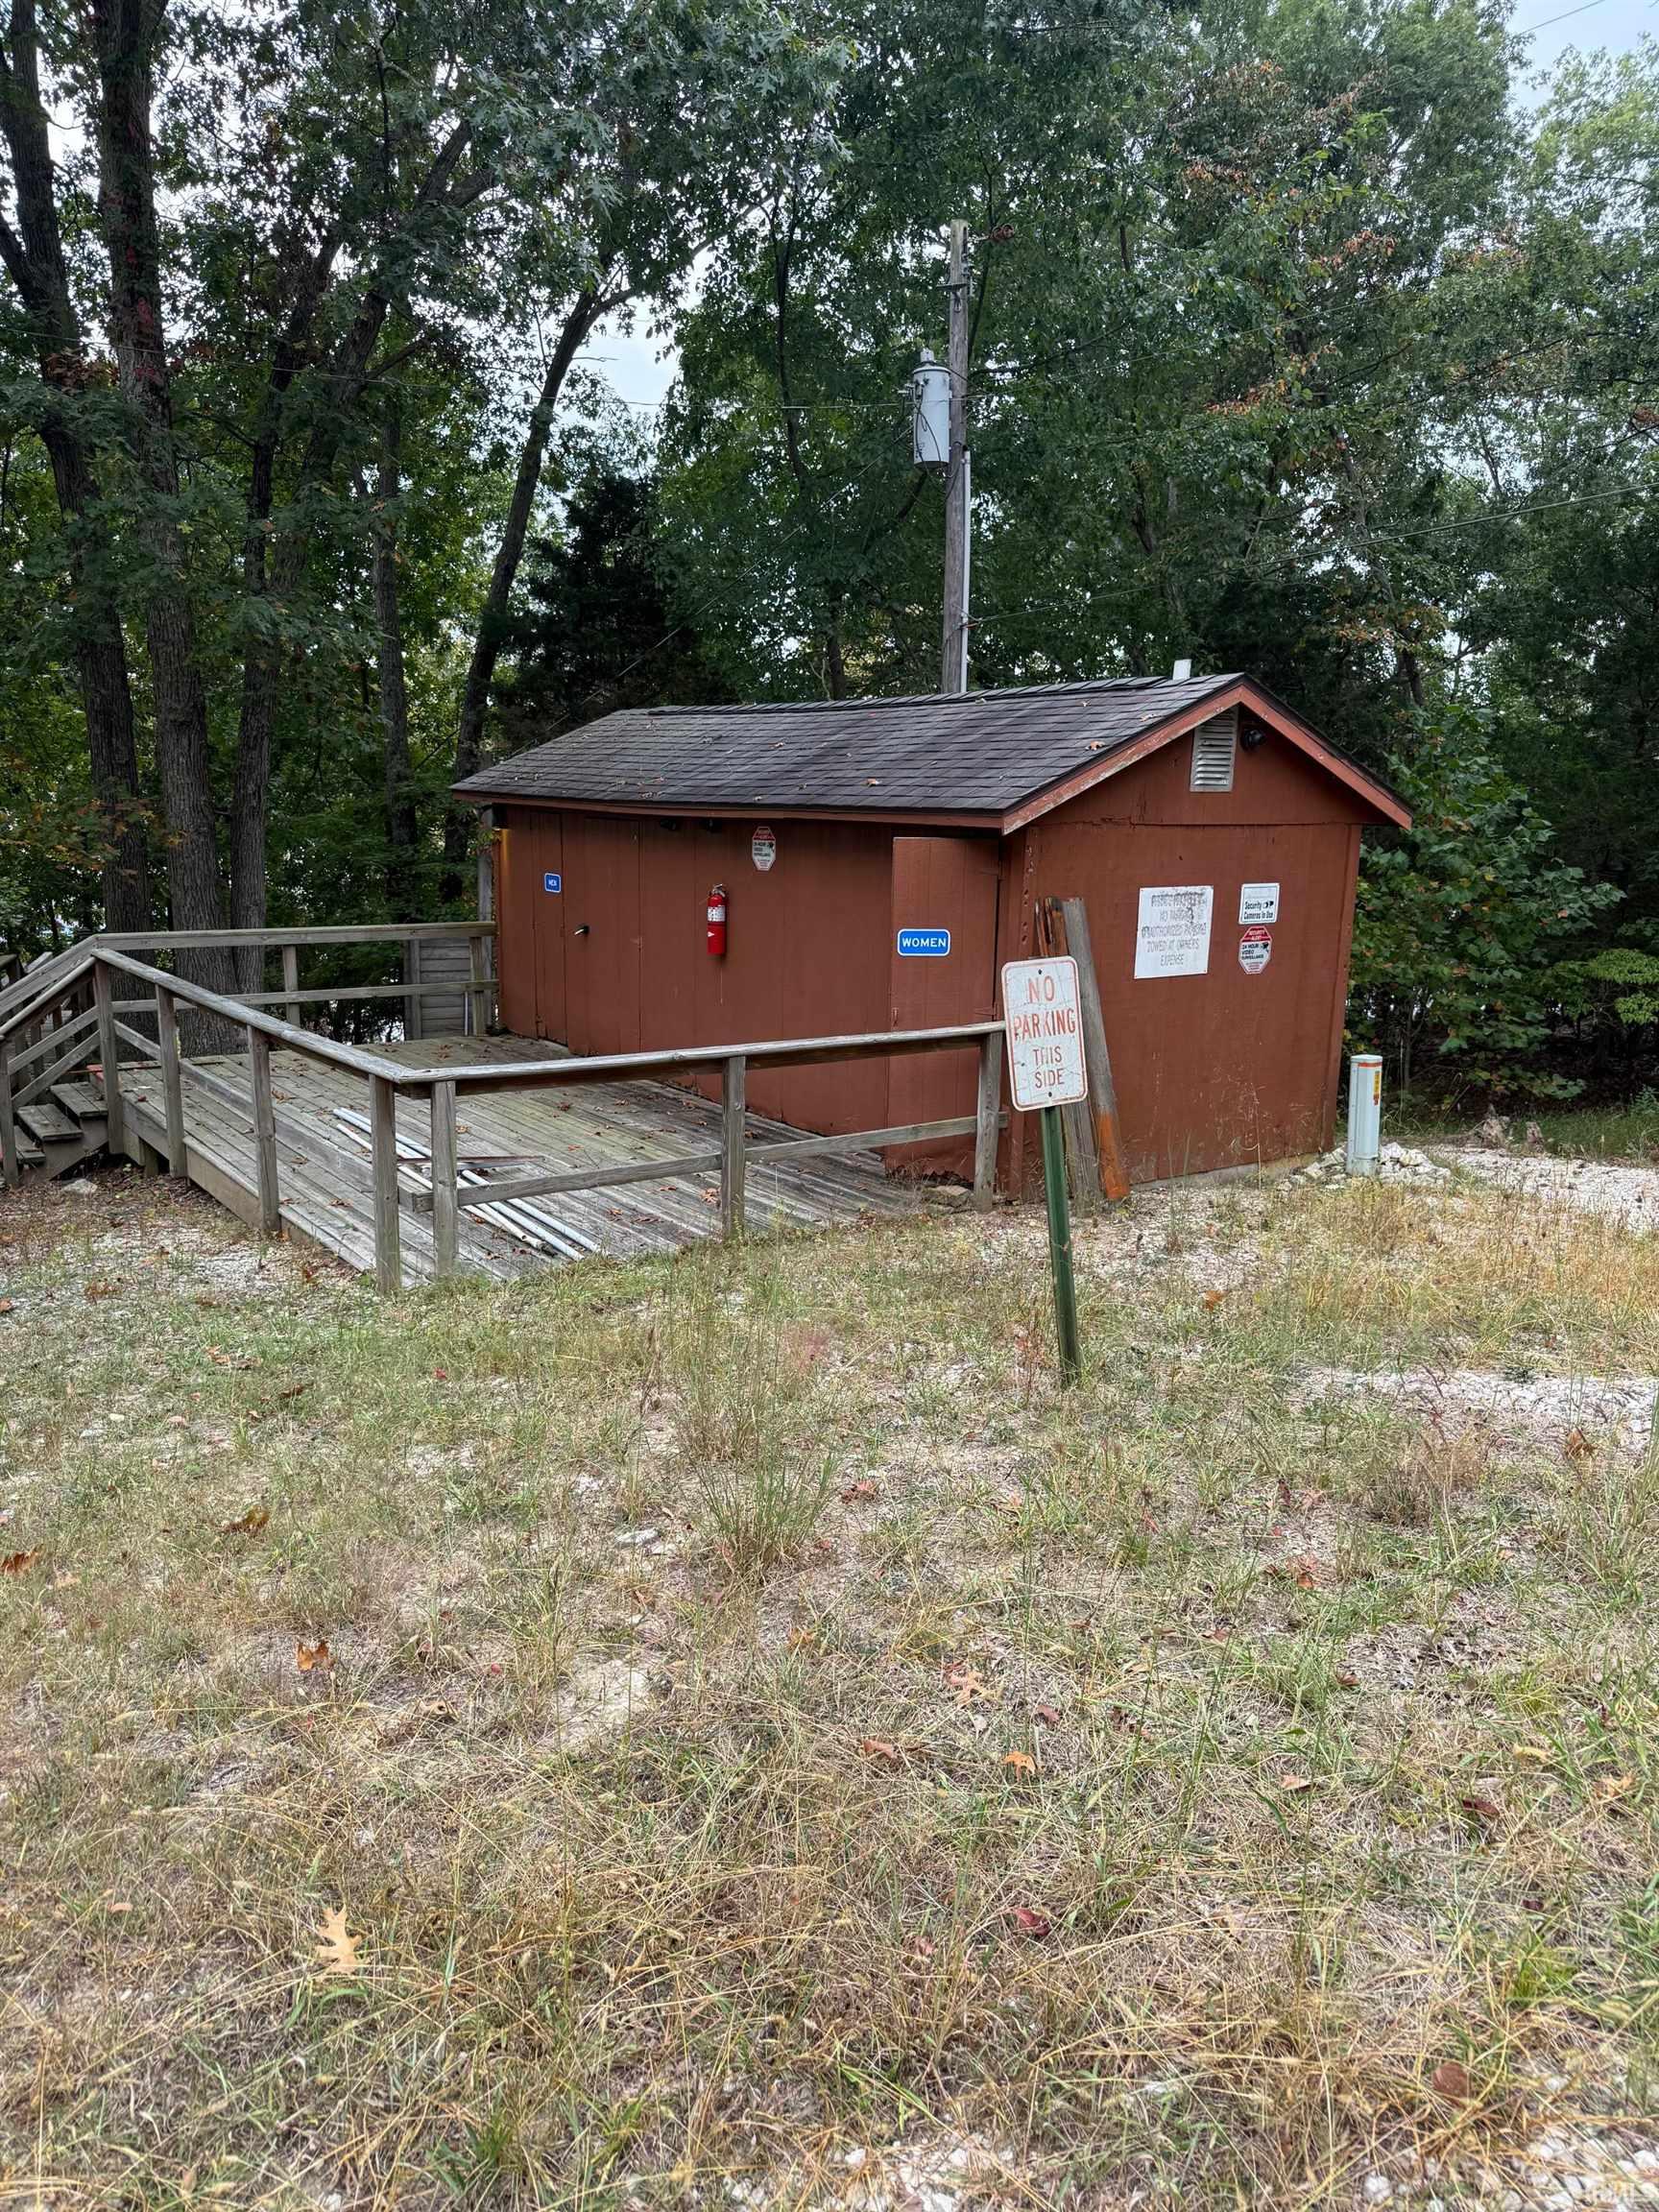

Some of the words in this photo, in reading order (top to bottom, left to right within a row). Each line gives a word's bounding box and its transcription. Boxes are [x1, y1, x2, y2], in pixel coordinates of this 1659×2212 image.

[1244, 901, 1262, 910] Security
[902, 937, 947, 948] WOMEN
[1027, 974, 1056, 1004] NO
[1013, 1007, 1076, 1042] PARKING
[1032, 1046, 1063, 1067] THIS
[1035, 1068, 1065, 1089] SIDE
